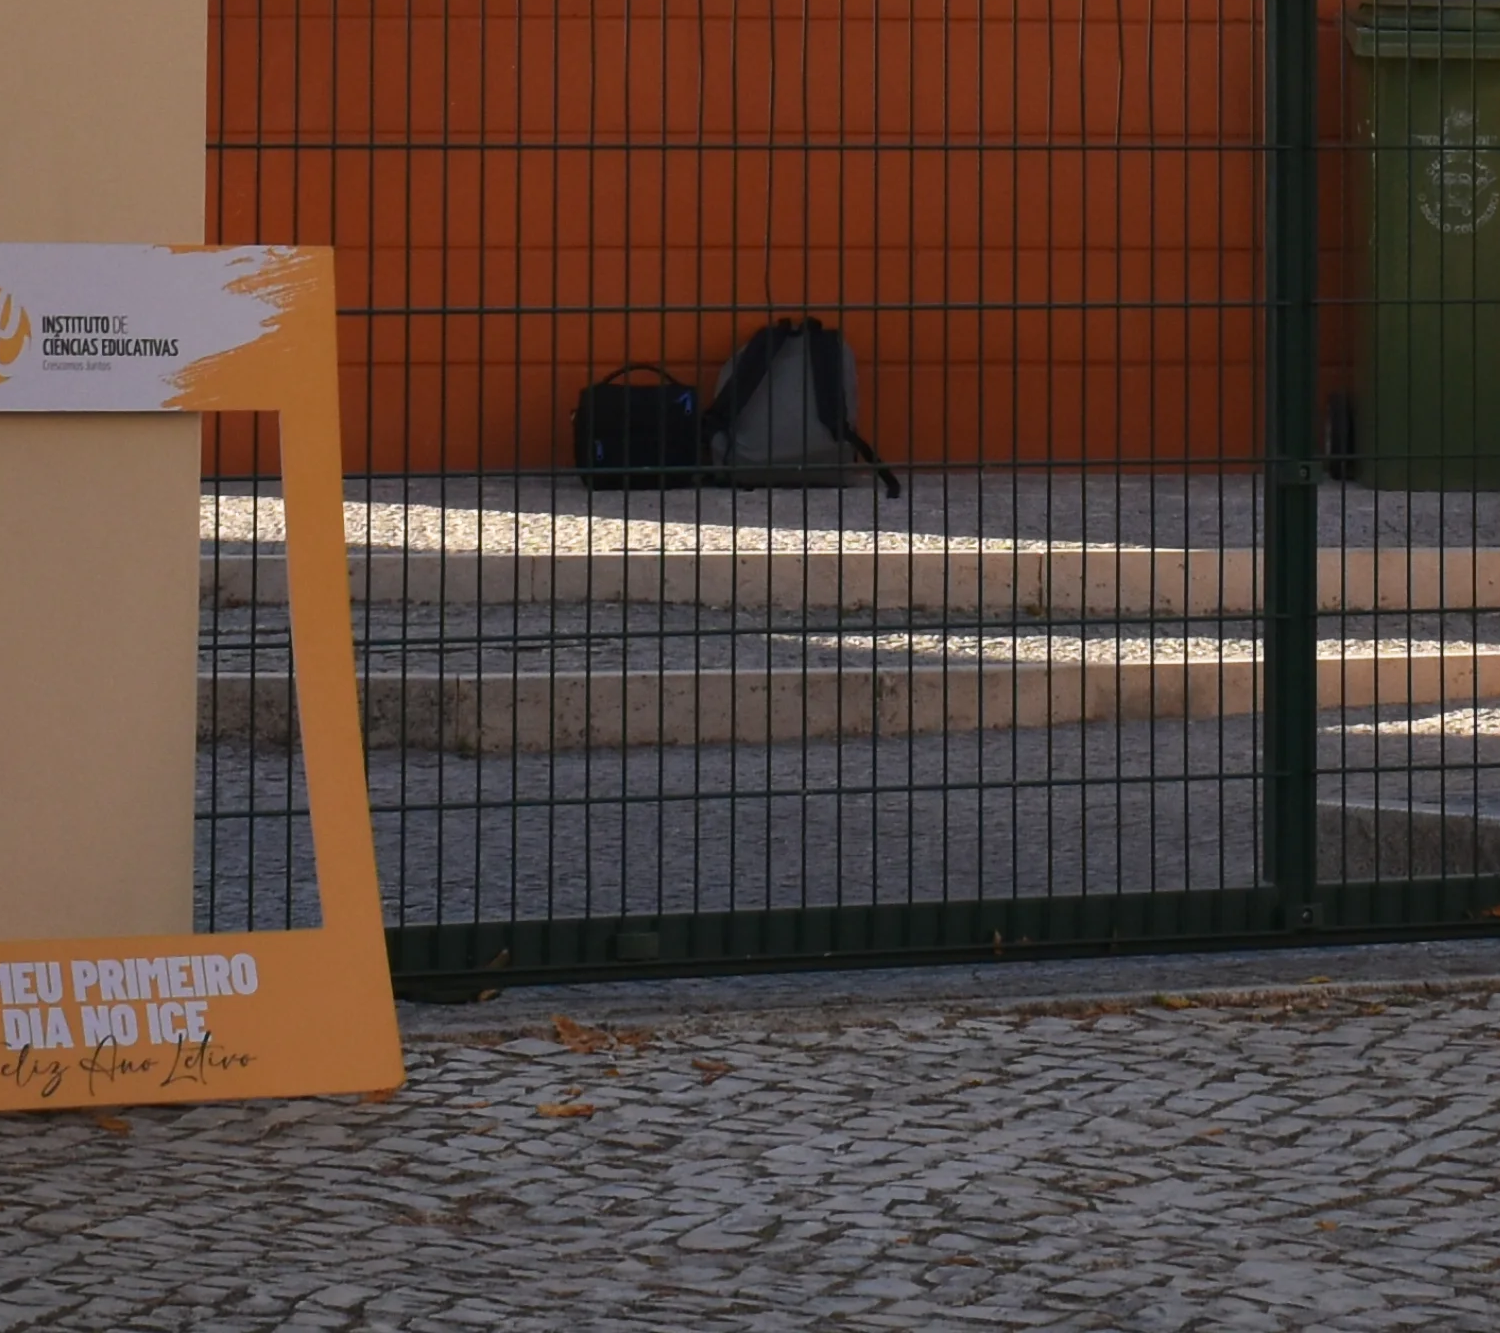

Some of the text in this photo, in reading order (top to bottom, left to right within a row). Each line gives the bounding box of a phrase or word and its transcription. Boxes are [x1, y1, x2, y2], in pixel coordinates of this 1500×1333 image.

[42, 315, 128, 334] INSTITUTO DE
[42, 331, 179, 357] CIÊNCIAS EDUCATIVAS
[71, 953, 258, 1002] PRIMEIRO
[2, 1001, 212, 1051] DIA NO ICE
[79, 1034, 159, 1096] Ano
[160, 1030, 258, 1086] Letivo
